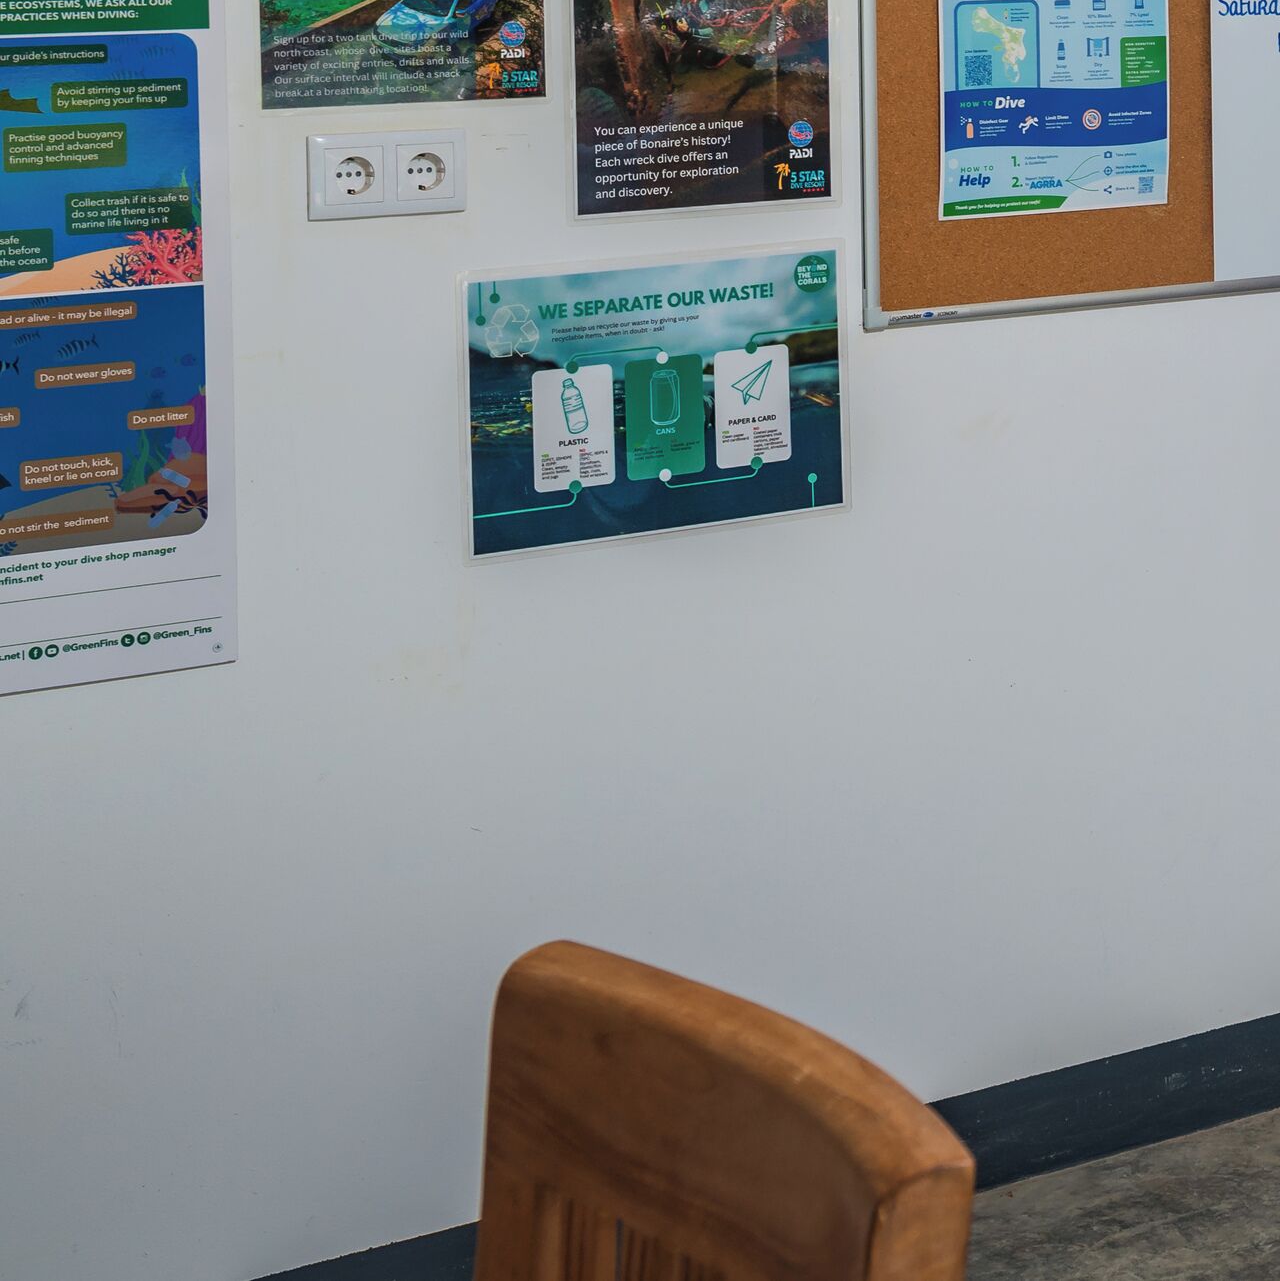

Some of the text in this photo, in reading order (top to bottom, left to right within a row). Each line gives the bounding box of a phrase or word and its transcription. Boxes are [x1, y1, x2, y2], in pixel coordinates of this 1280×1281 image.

[61, 11, 95, 21] WHEN
[98, 10, 139, 19] DIVING:
[500, 49, 526, 59] PADI
[995, 96, 1025, 109] Dive
[594, 119, 744, 136] You can experience a unique
[594, 141, 624, 154] piece
[626, 140, 638, 150] of
[691, 135, 730, 149] history!
[595, 151, 728, 168] Each wreck dive offers an
[789, 148, 812, 159] PADI
[595, 165, 739, 185] opportunity for exploration
[790, 170, 825, 183] 5 STAR
[959, 173, 991, 188] Help
[1030, 179, 1063, 190] AGRRA
[595, 185, 672, 199] and discovery.
[538, 283, 774, 320] WE SEPARATE OUR WASTE!
[40, 367, 132, 383] Do not wear gloves
[728, 417, 751, 427] PAPER
[758, 415, 777, 423] CARD
[656, 427, 676, 435] CANS
[558, 437, 589, 448] PLASTIC
